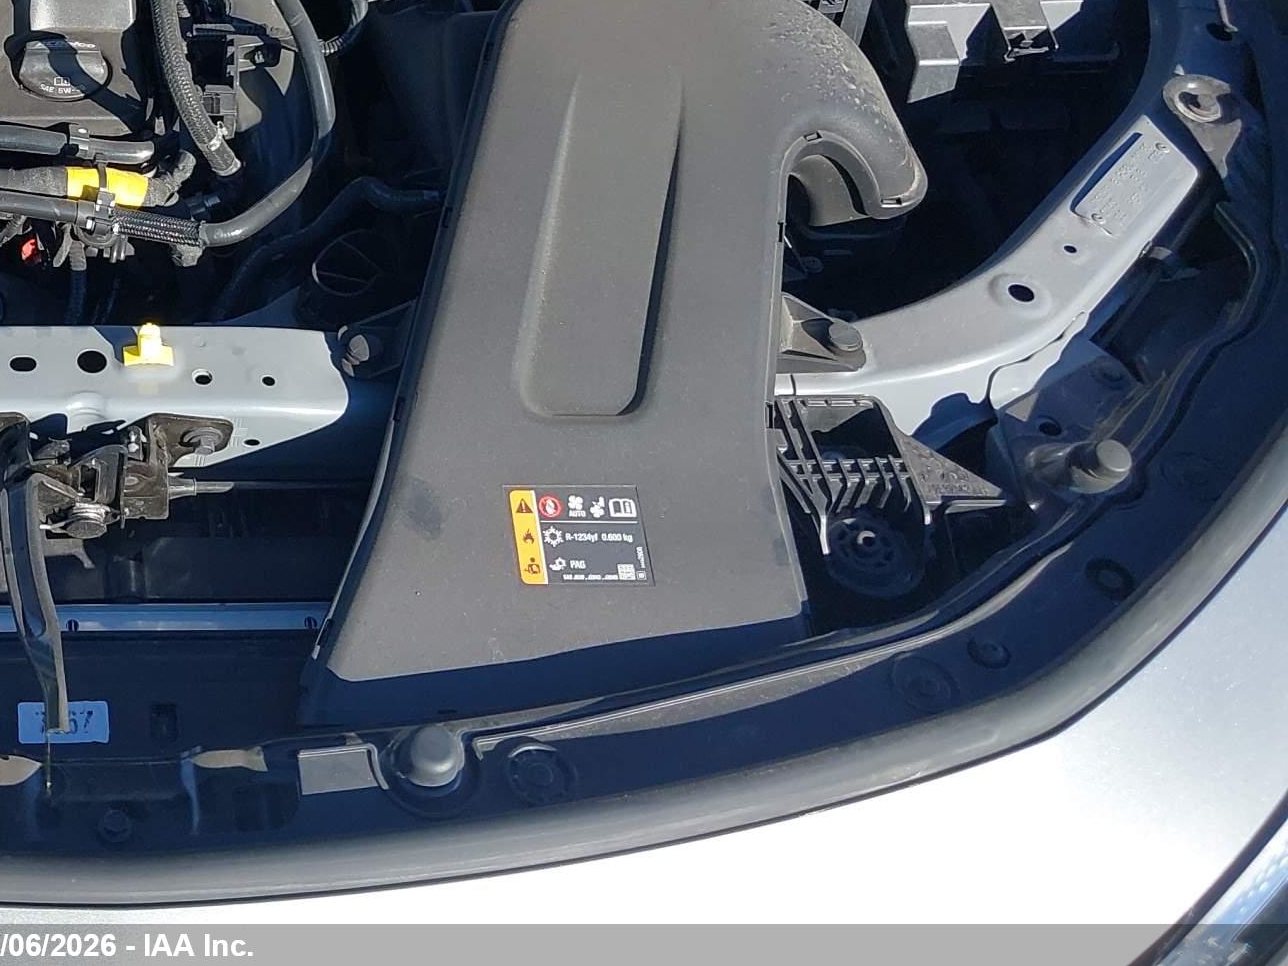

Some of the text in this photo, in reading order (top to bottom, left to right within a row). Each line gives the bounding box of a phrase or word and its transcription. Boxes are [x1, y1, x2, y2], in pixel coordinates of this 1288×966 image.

[40, 83, 55, 93] SAE
[565, 533, 598, 542] R-1234yf
[623, 533, 633, 543] kg
[570, 560, 586, 569] PAG
